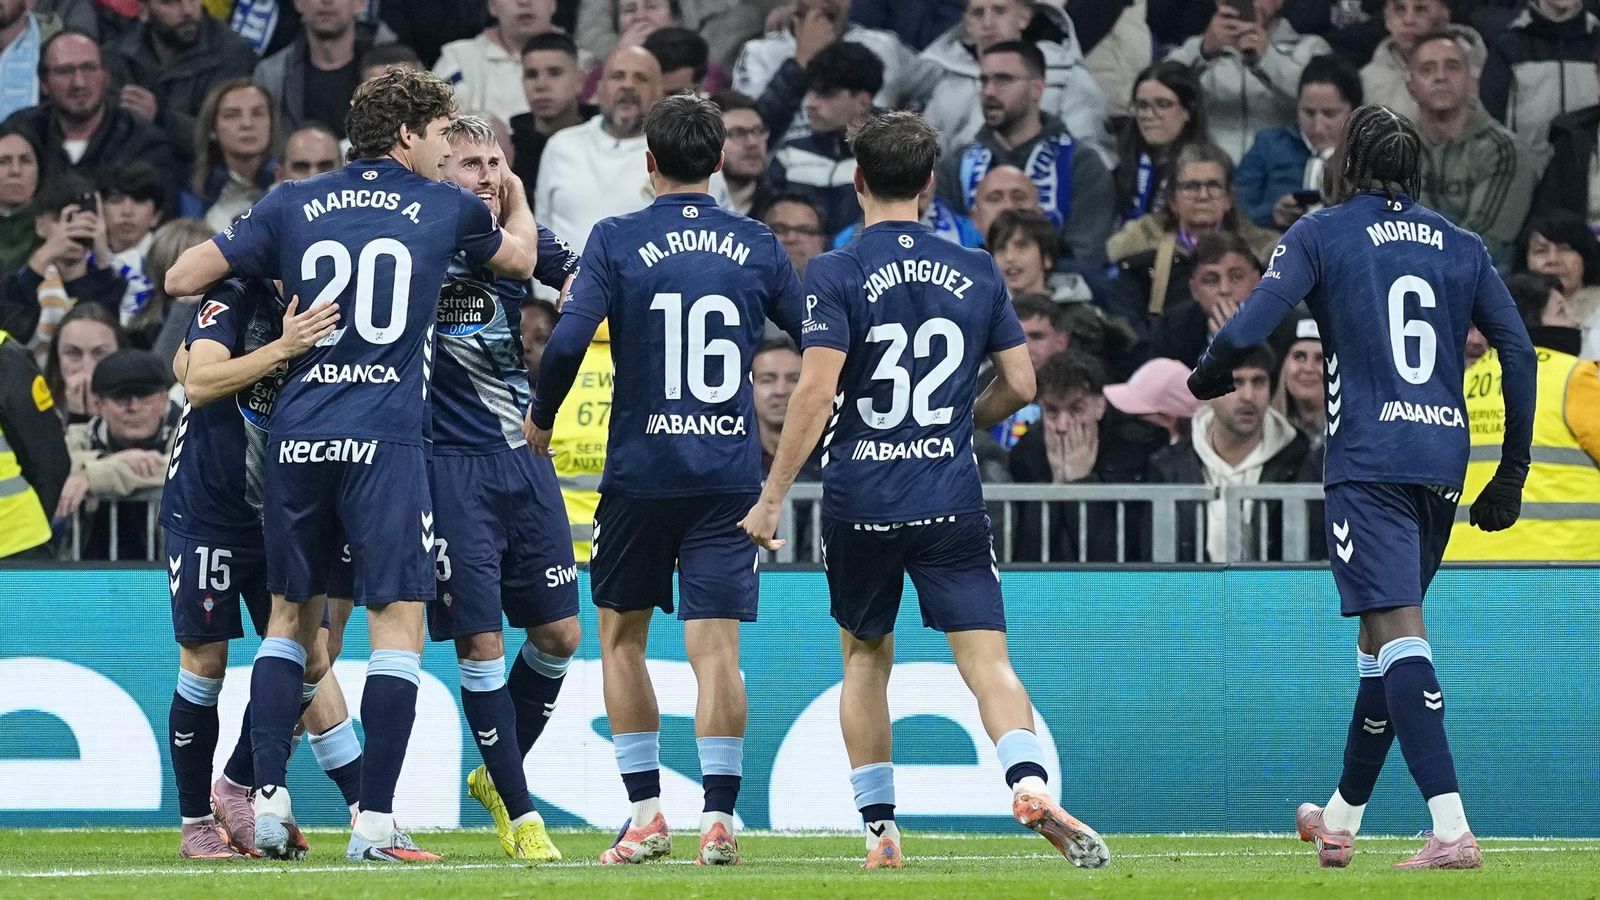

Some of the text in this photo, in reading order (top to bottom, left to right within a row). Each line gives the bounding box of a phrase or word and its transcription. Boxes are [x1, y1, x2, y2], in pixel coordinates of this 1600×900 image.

[303, 190, 422, 224] MARCOS A.
[1366, 221, 1443, 250] MORIBA
[301, 237, 413, 347] 20
[863, 260, 973, 303] JAVI RGUEZ
[436, 308, 482, 323] Galicia
[1388, 274, 1437, 385] 6
[650, 293, 741, 404] 16
[857, 317, 965, 430] 32
[195, 546, 233, 591] 15
